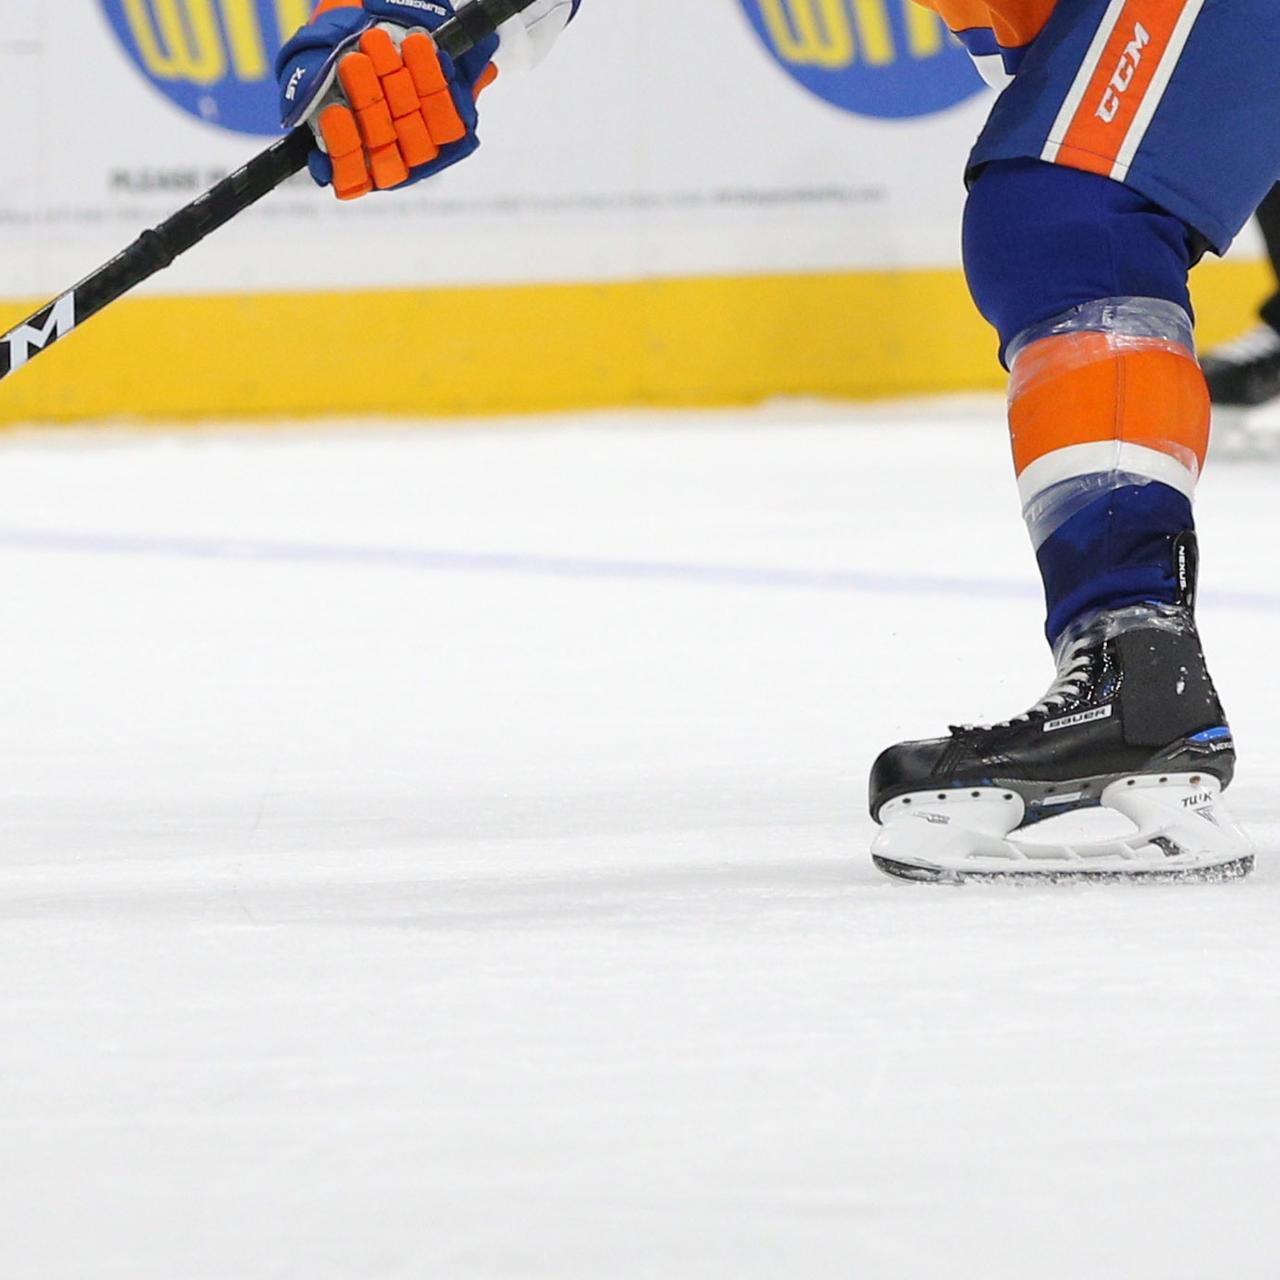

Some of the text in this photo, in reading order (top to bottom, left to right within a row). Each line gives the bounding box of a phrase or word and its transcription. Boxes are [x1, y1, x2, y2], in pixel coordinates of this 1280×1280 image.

[284, 66, 307, 101] STX
[1093, 20, 1151, 124] CCM
[1177, 544, 1188, 592] NEXUS
[1048, 707, 1107, 729] BAUER
